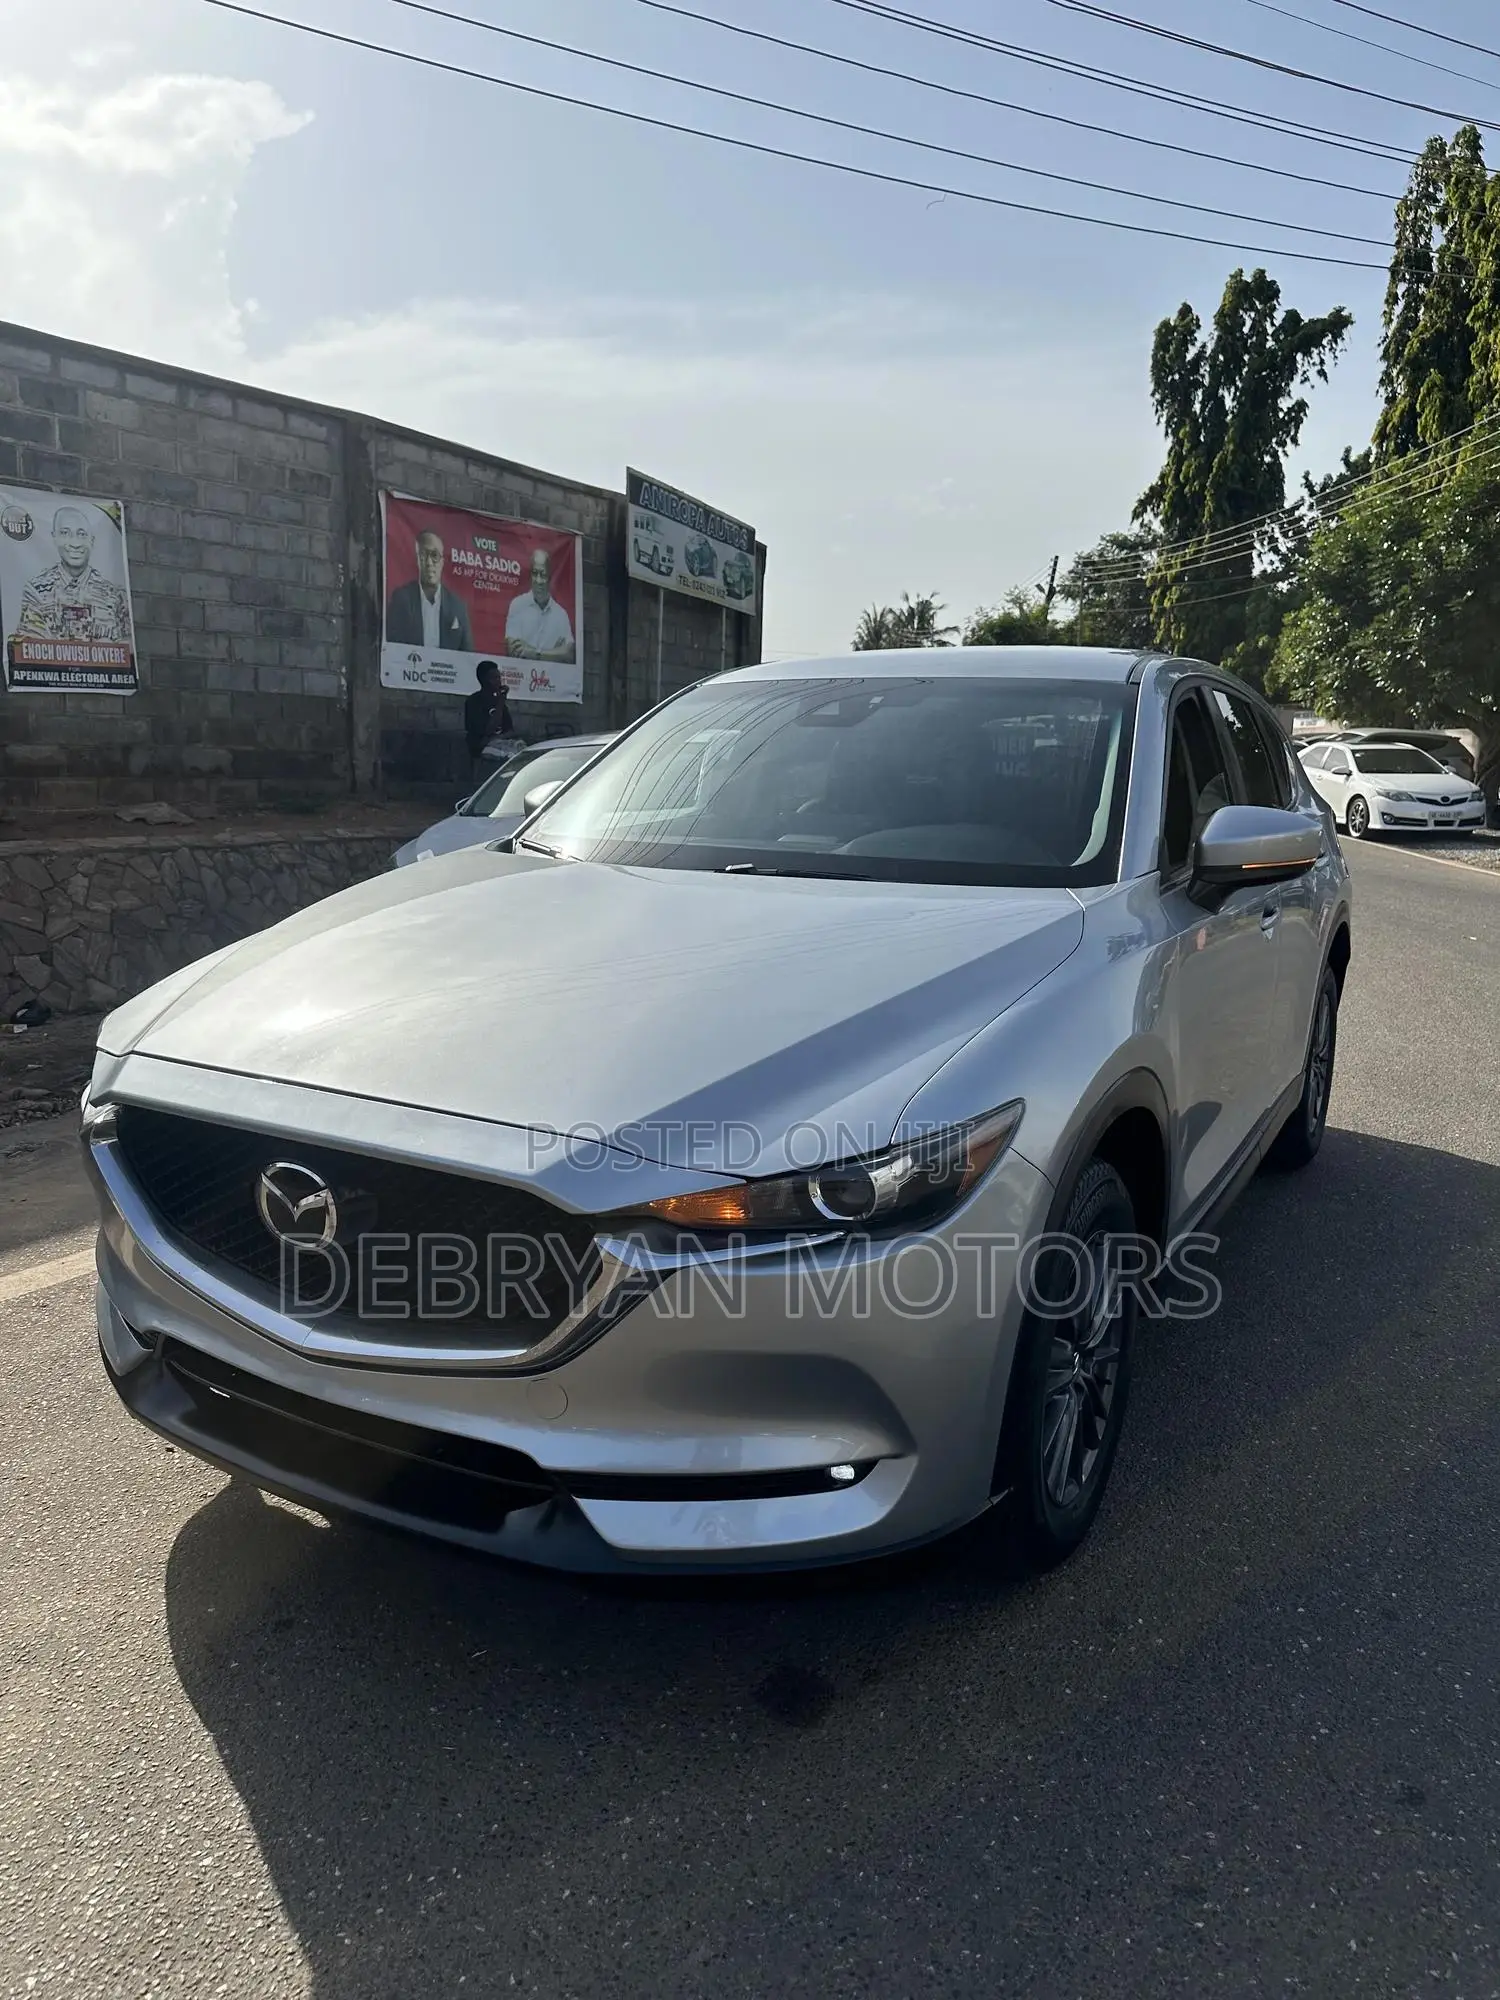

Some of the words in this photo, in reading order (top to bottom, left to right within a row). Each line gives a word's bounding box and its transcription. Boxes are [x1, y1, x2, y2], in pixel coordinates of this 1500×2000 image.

[706, 514, 749, 550] AUTOS
[474, 536, 497, 551] VOTE
[451, 548, 483, 568] BABA
[485, 555, 521, 576] SADIQ
[452, 566, 462, 576] AS
[475, 570, 488, 580] FOR
[473, 579, 501, 592] CENTRAL
[22, 642, 54, 660] ENOCH
[55, 645, 89, 662] OWUSU
[91, 646, 126, 664] OKYERE
[13, 670, 60, 681] APENKWA
[61, 672, 110, 683] ELECTORAL
[111, 674, 135, 684] AREA
[403, 670, 427, 683] NDC
